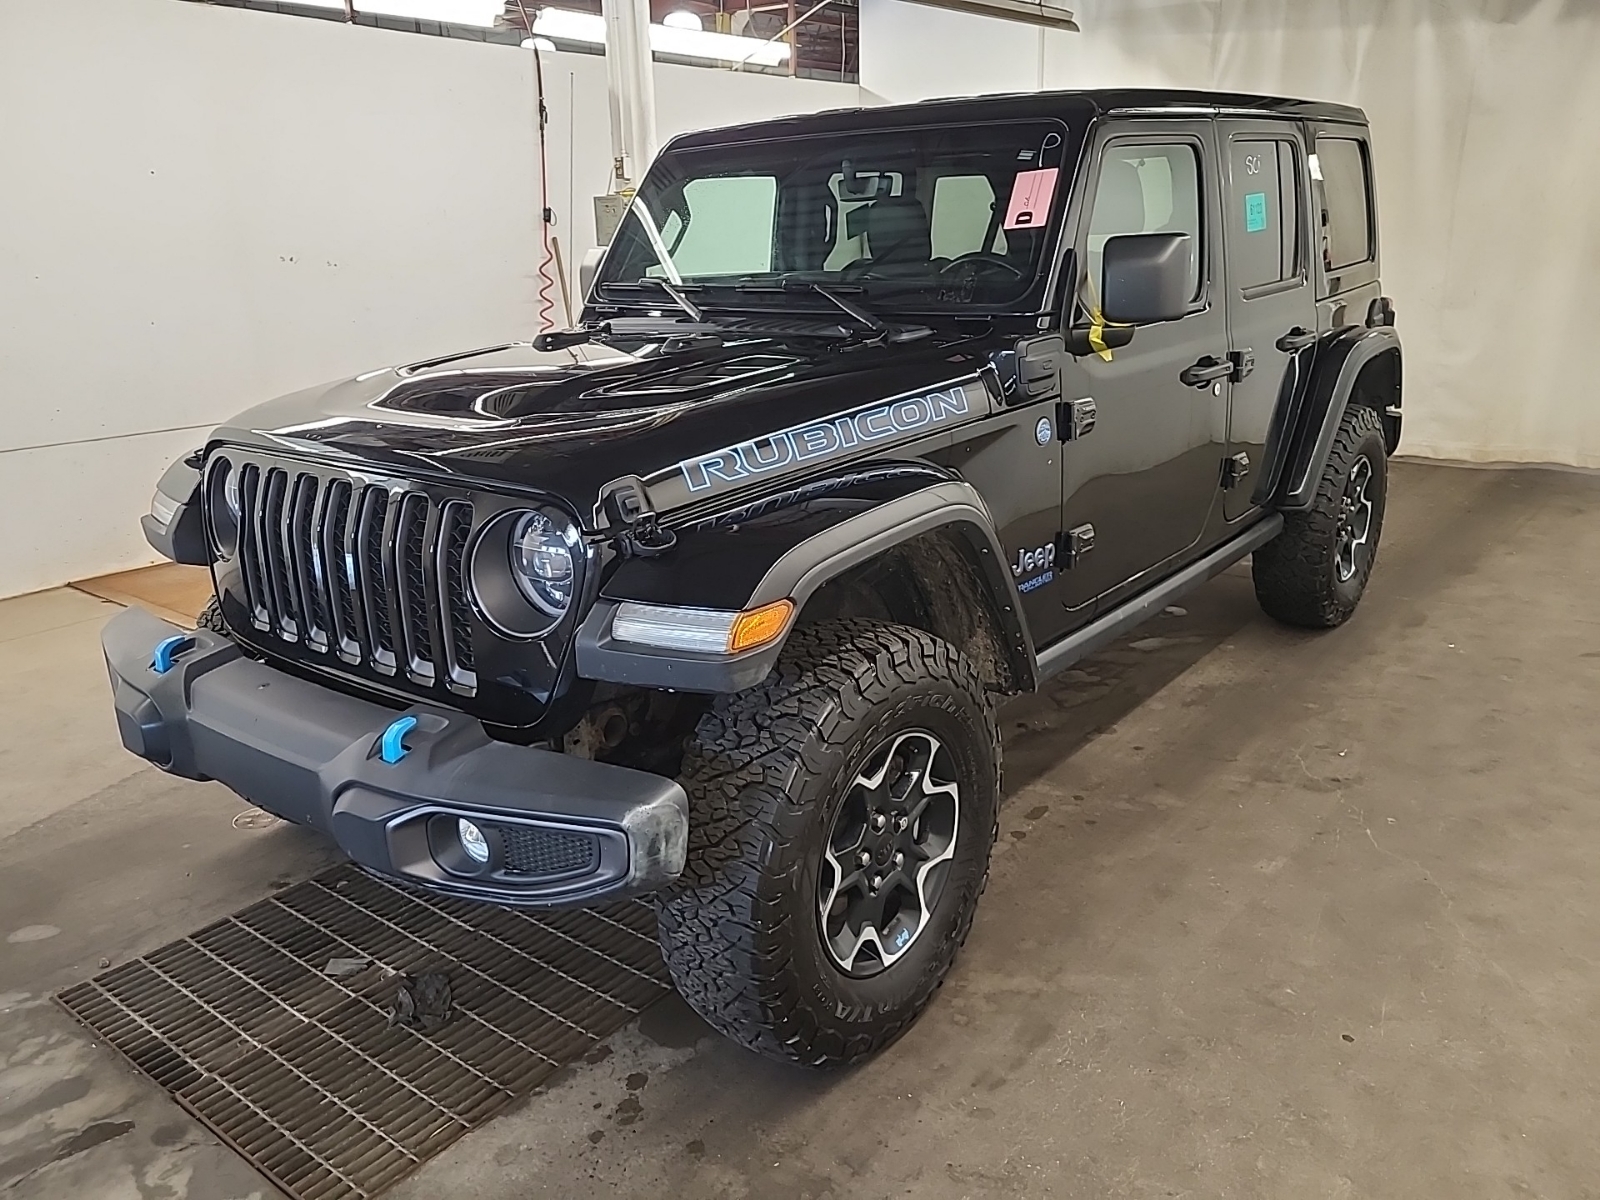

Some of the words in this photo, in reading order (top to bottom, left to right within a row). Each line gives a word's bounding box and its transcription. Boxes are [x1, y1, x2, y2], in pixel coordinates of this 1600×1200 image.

[1014, 211, 1033, 226] D
[680, 386, 969, 492] RUBICON
[1012, 543, 1055, 577] Jeep
